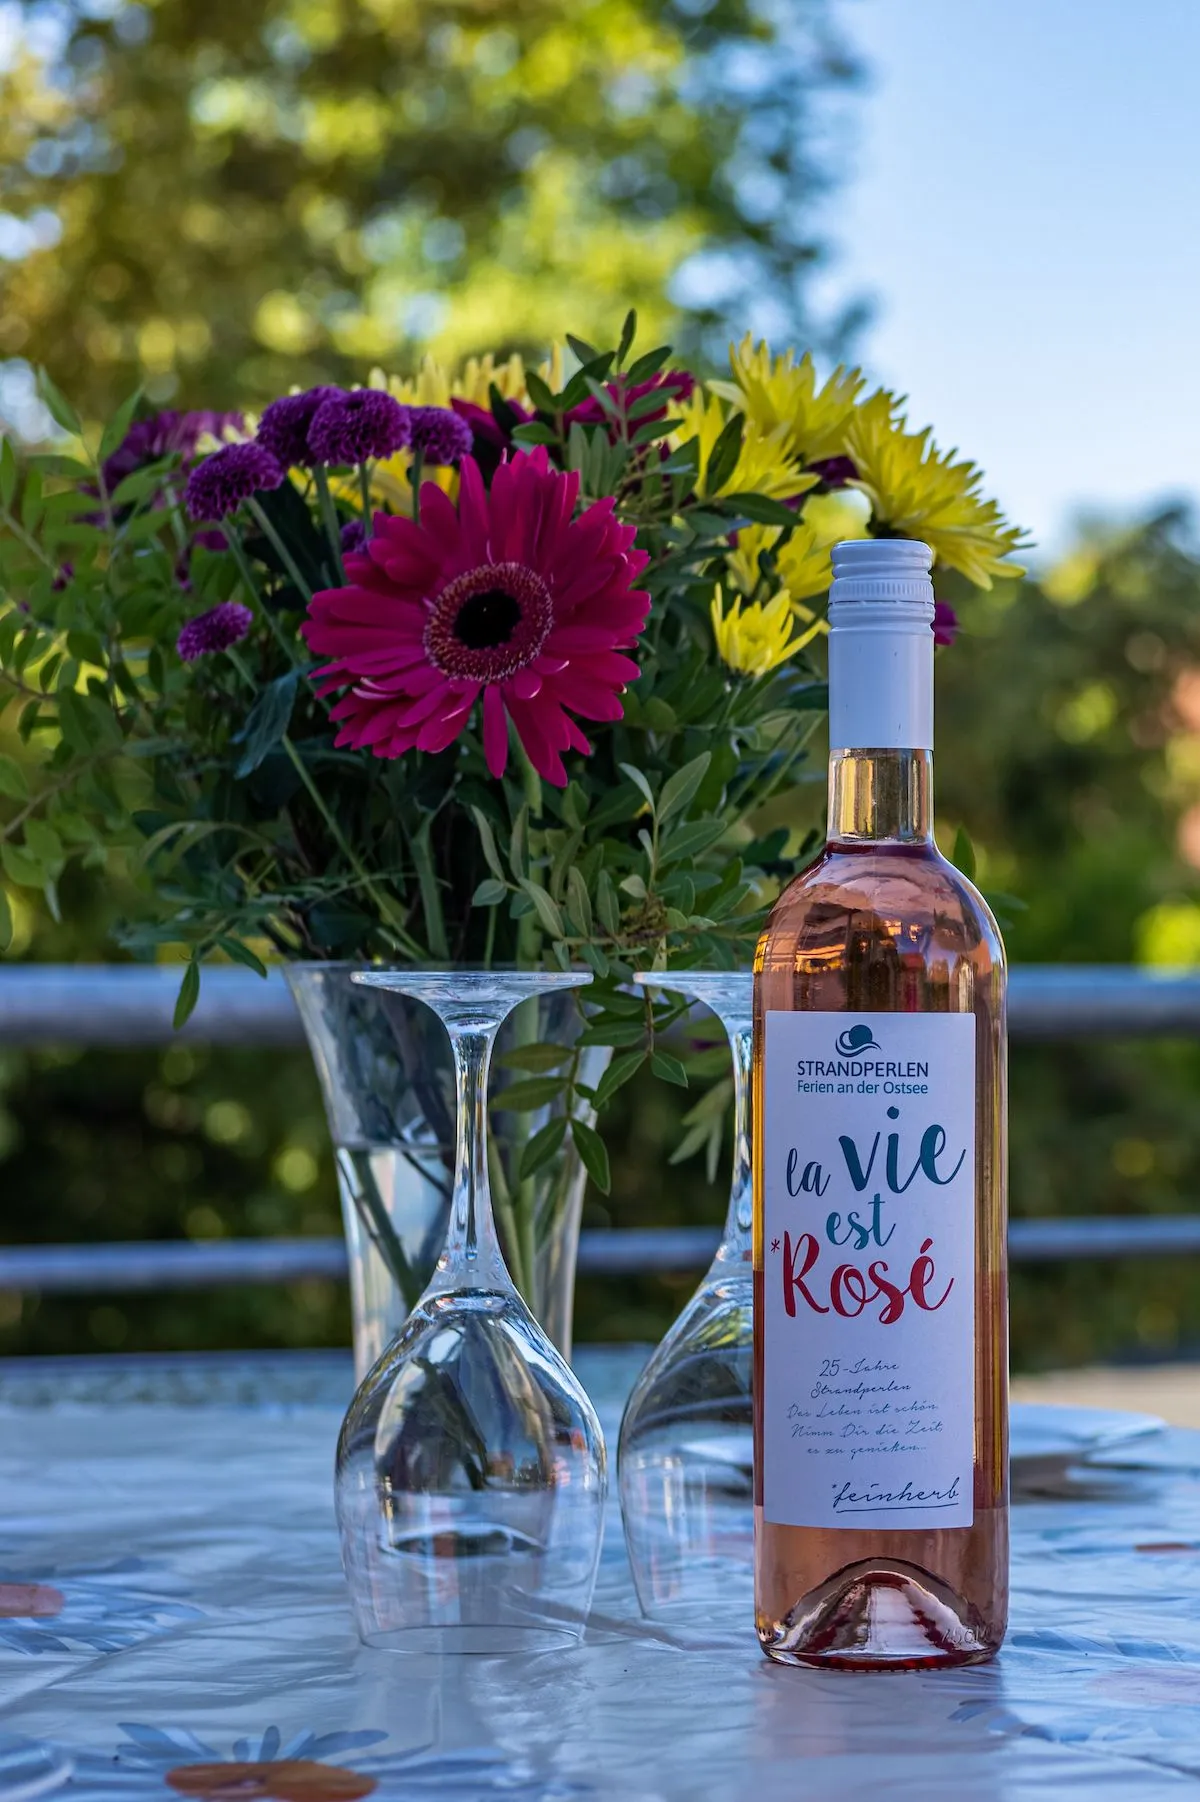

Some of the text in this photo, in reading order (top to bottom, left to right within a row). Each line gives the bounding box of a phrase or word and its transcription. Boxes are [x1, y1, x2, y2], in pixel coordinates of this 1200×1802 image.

[797, 1060, 929, 1078] STRANDPERLEN
[797, 1080, 929, 1095] Ferien an der Ostsee
[786, 1105, 967, 1197] la vie
[825, 1193, 896, 1250] est
[810, 1380, 912, 1400] Strandperlen
[786, 1404, 811, 1419] Das
[816, 1402, 863, 1418] Leben
[868, 1403, 890, 1415] ist
[791, 1423, 834, 1439] Nimm
[840, 1423, 870, 1438] Dir
[875, 1424, 899, 1436] die
[806, 1447, 821, 1455] es
[824, 1447, 846, 1456] zu
